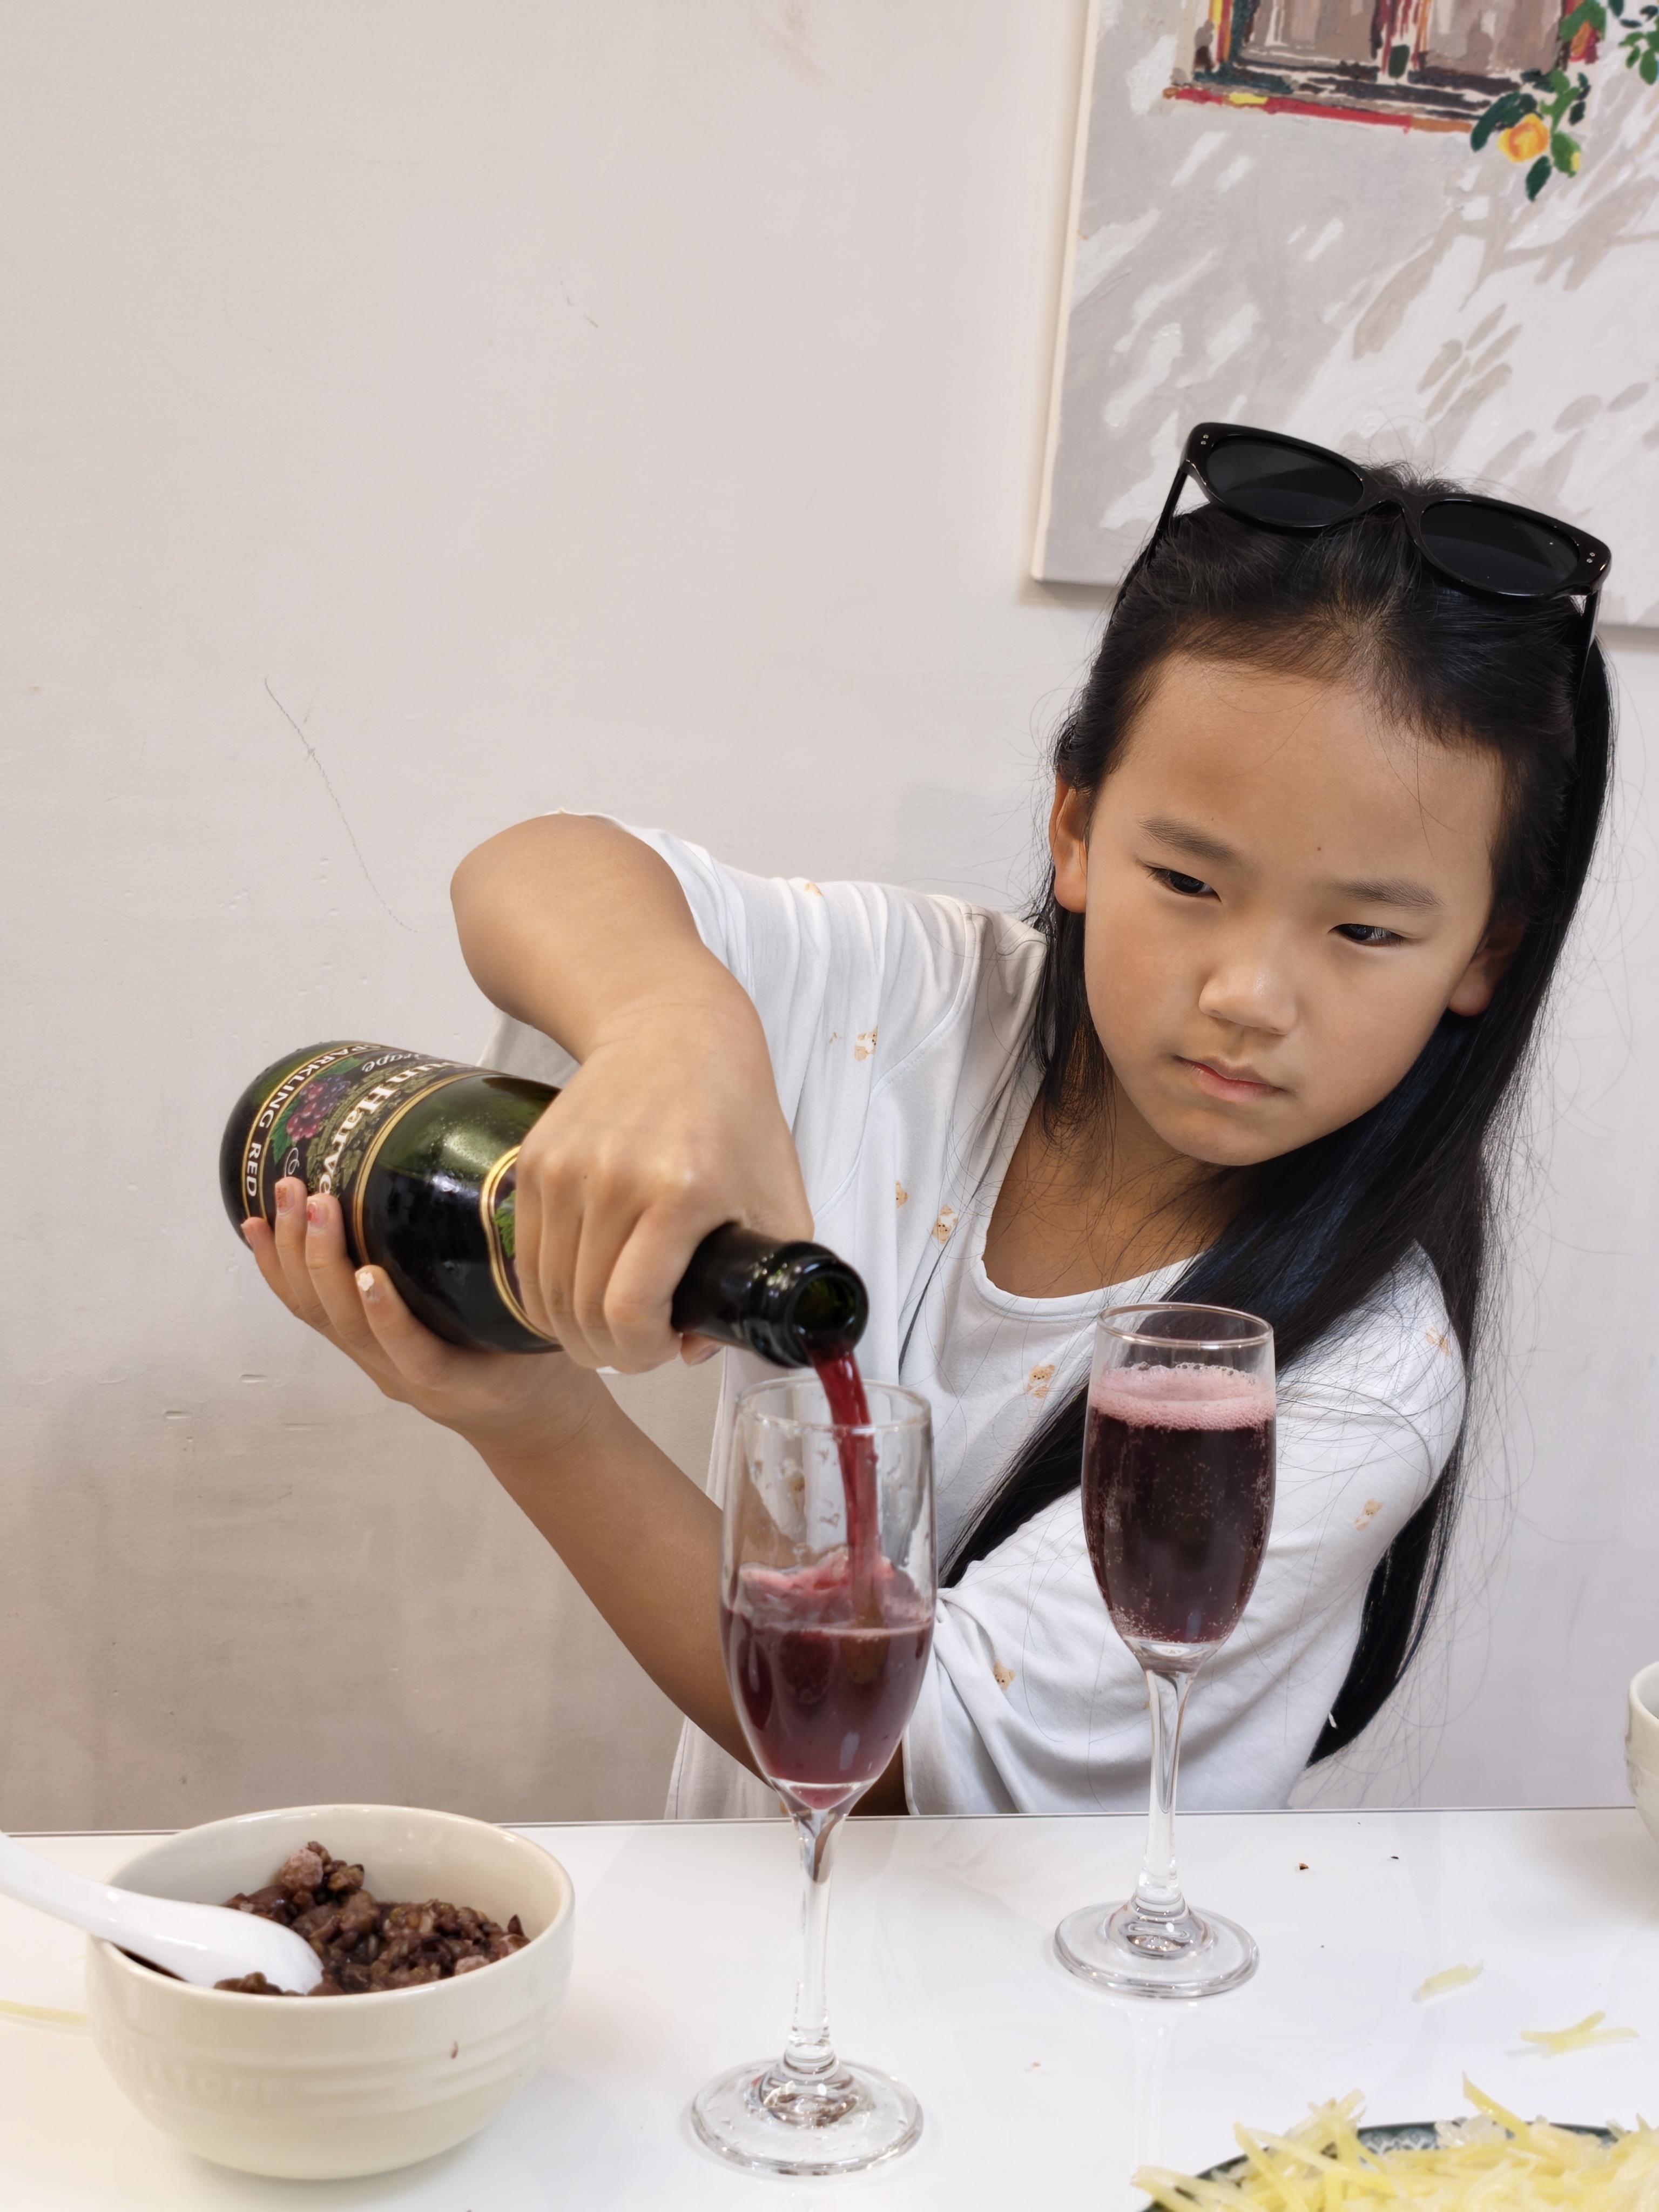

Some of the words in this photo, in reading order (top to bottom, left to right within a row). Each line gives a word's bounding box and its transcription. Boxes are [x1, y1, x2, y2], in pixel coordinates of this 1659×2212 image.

[362, 1053, 421, 1073] rape
[386, 1061, 475, 1083] un
[246, 1142, 262, 1197] RED
